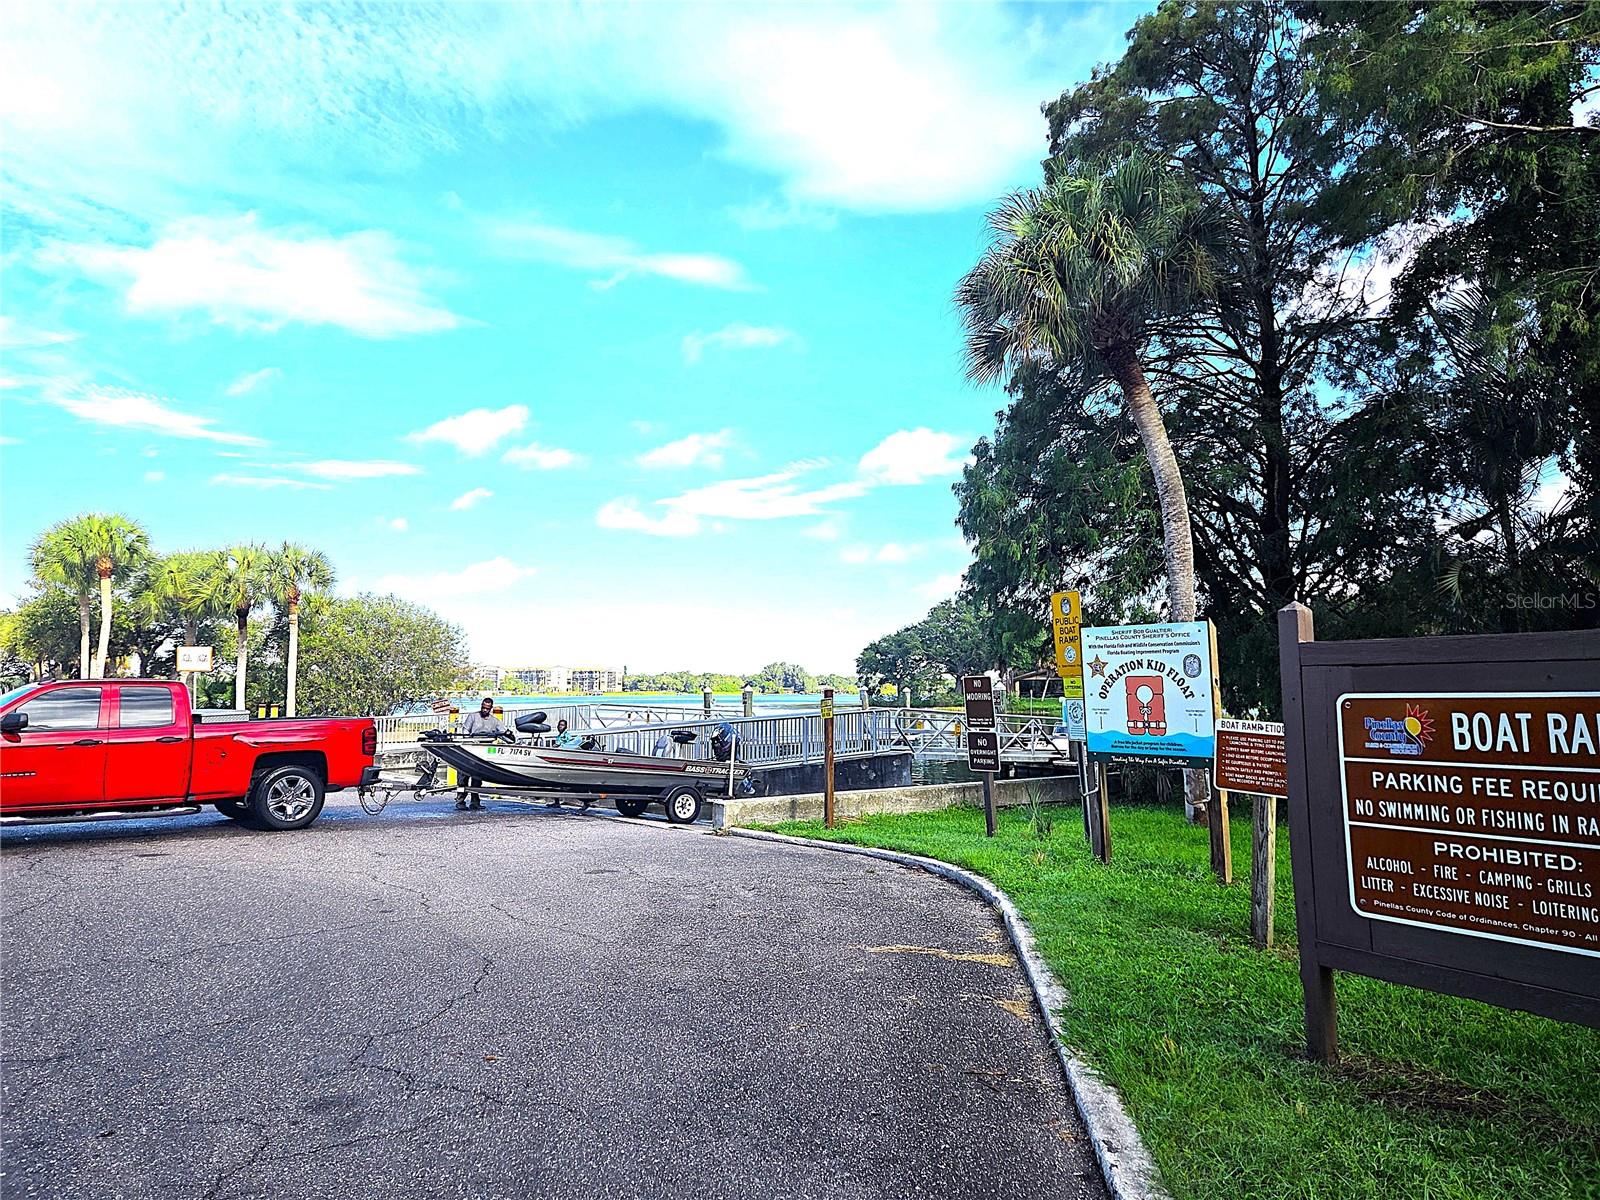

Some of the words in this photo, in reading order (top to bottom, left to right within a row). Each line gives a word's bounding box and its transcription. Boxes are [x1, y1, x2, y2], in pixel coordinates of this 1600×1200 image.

[1055, 616, 1079, 626] PUBLIC
[1059, 626, 1076, 635] BOAT
[1059, 636, 1079, 644] RAMP
[973, 680, 982, 688] NO
[1099, 659, 1144, 699] OPERATION
[1147, 659, 1166, 673] KID
[1166, 667, 1195, 699] FLOAT
[1221, 721, 1239, 730] BOAT
[1242, 722, 1262, 731] RAMP
[1364, 716, 1405, 730] Pinellas
[1451, 712, 1532, 753] BOAT
[1546, 712, 1600, 755] RA
[977, 738, 988, 747] NO
[510, 748, 522, 756] 7174
[973, 757, 995, 765] PARKING
[1372, 771, 1463, 794] PARKING
[1472, 777, 1514, 798] FEE
[1522, 779, 1600, 803] REQUI
[1355, 799, 1373, 816] NO
[1379, 801, 1450, 823] SWIMMING
[1456, 807, 1476, 826] OR
[1482, 809, 1545, 832] FISHING
[1552, 814, 1570, 834] IN
[1577, 816, 1600, 836] RA
[1434, 842, 1582, 872] PROHIBITED:
[1367, 856, 1414, 875] ALCOHOL
[1434, 865, 1458, 880] FIRE
[1480, 871, 1532, 890] CAMPING
[1547, 879, 1592, 898] GRILLS
[1361, 876, 1394, 893] LITTER
[1413, 883, 1471, 904] EXCESSIVE
[1475, 892, 1510, 910] NOISE
[1532, 900, 1599, 923] LOITERING
[1373, 900, 1404, 911] Pinellas
[1405, 905, 1433, 916] County
[1435, 910, 1457, 919] Code
[1522, 924, 1559, 936] Chapter
[1561, 930, 1576, 938] 90
